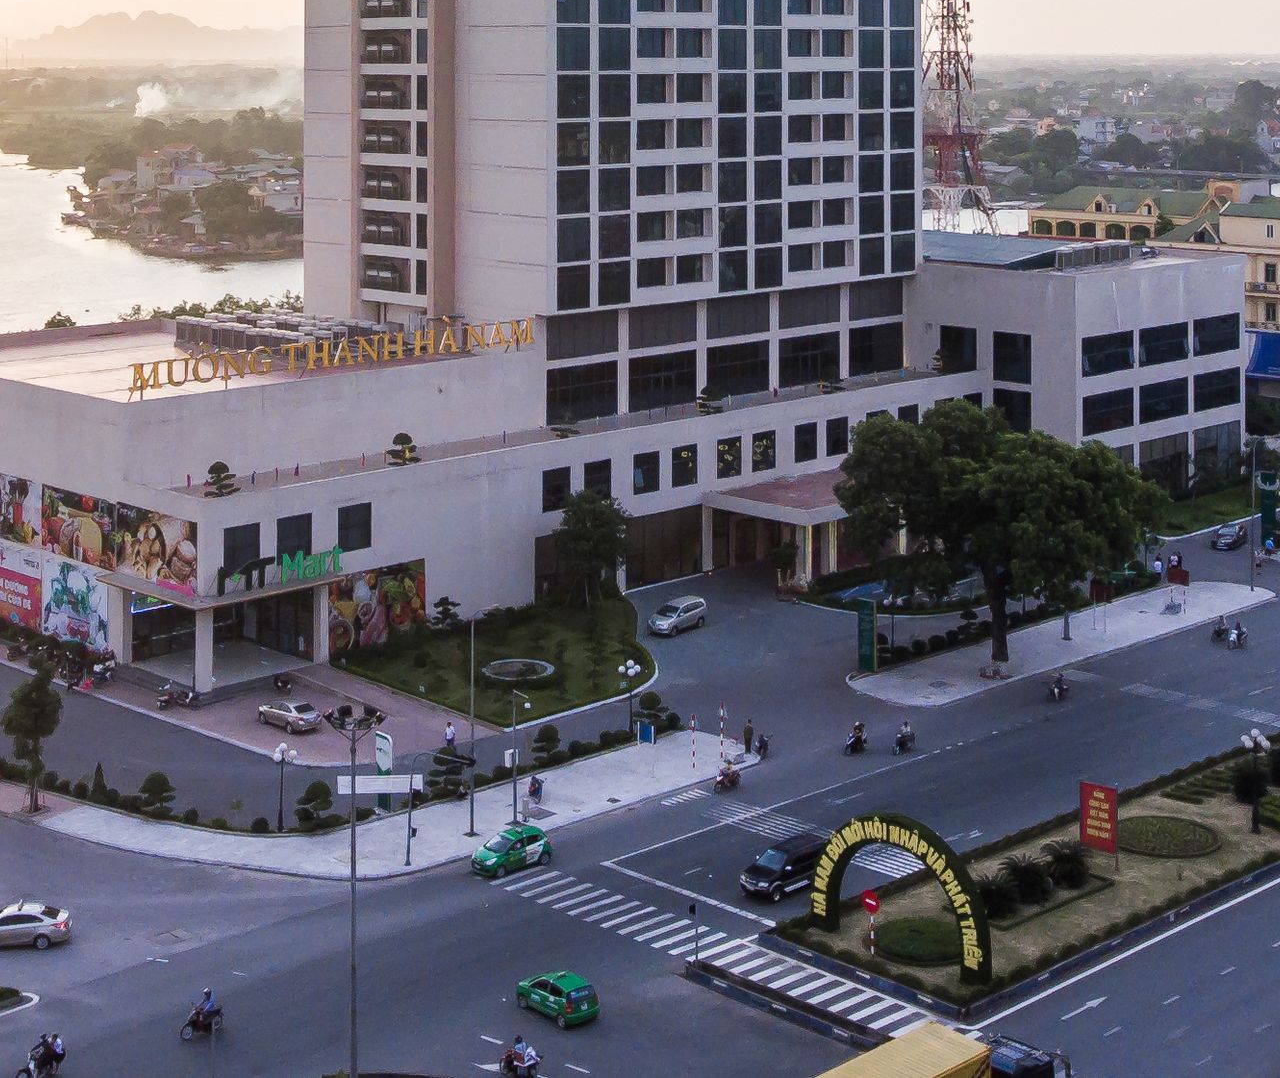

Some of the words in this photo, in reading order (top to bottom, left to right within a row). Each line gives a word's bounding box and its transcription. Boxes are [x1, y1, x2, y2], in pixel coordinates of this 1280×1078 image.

[282, 331, 406, 372] THANH
[414, 315, 459, 357] HÀ
[465, 317, 536, 351] NAM
[281, 544, 344, 586] Mart
[841, 818, 865, 846] MỚI
[864, 816, 887, 842] HỘI
[814, 855, 834, 891] NAM
[926, 846, 946, 876] VÀ
[810, 892, 827, 917] HÀ
[939, 868, 971, 915] PHÁT
